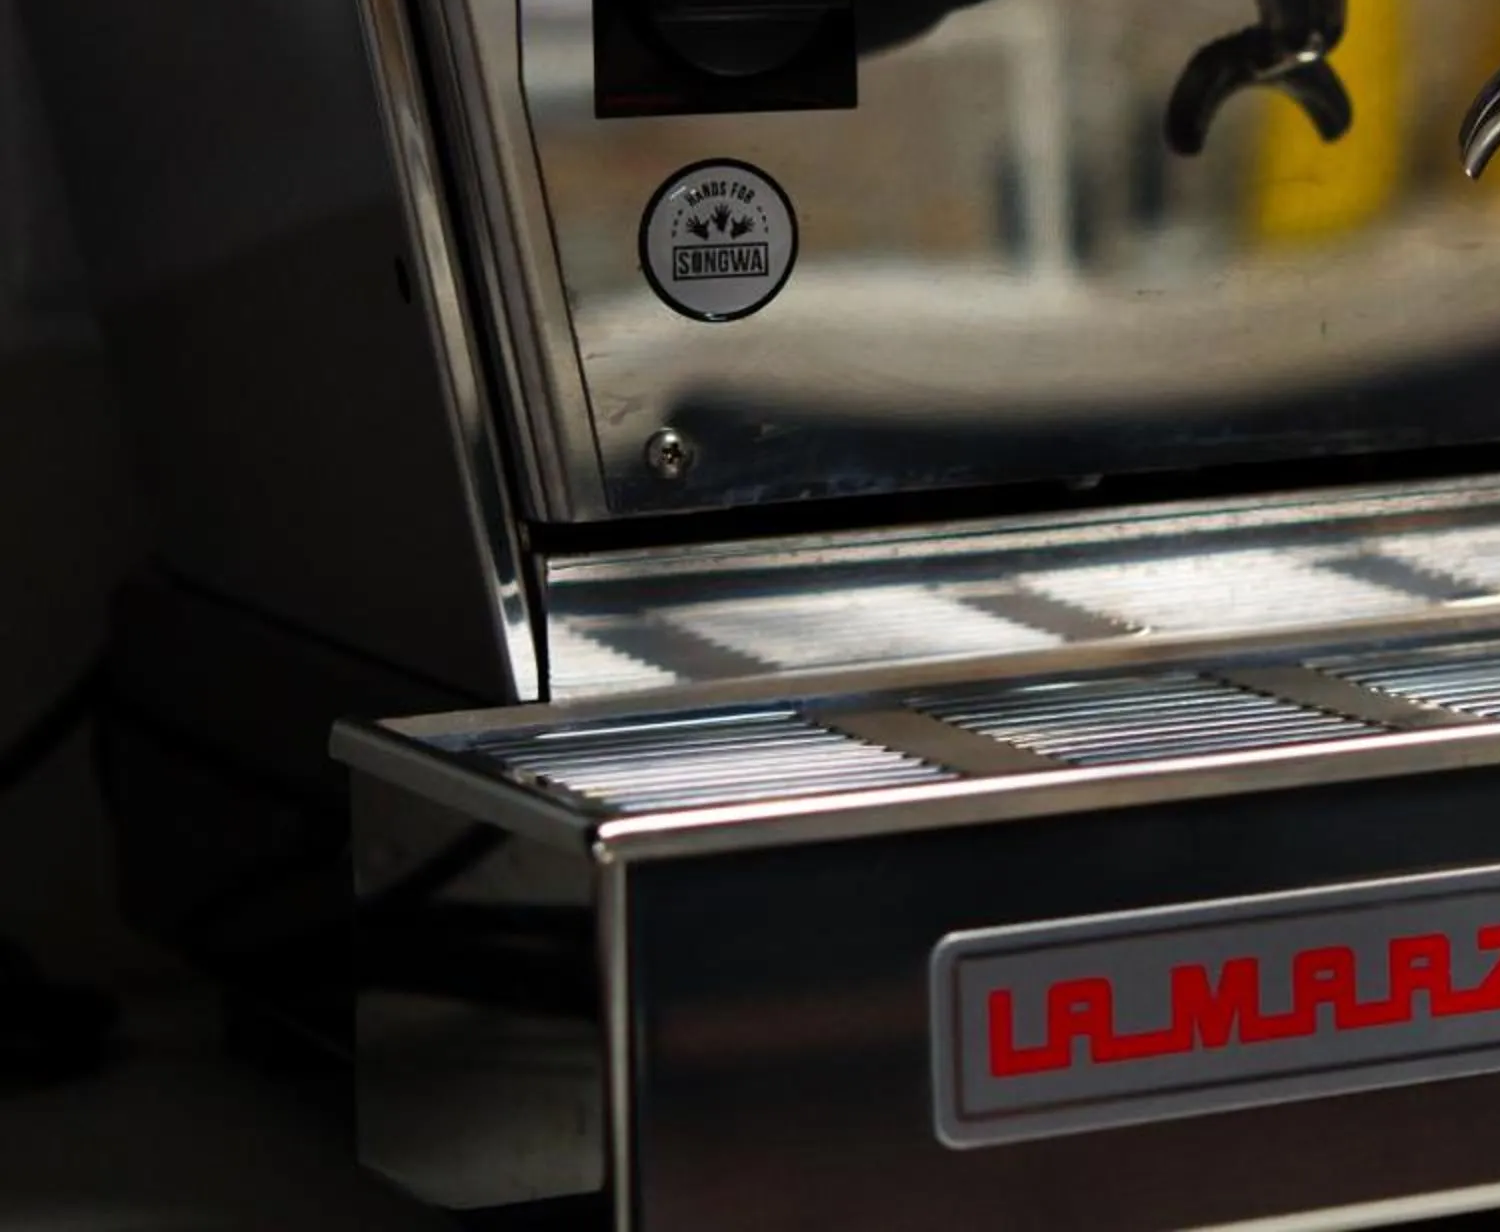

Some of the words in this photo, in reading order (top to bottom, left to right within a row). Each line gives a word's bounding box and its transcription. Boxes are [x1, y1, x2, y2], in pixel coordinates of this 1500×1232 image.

[731, 181, 755, 204] FOR
[678, 248, 763, 275] SONGWA
[988, 977, 1114, 1078] LA
